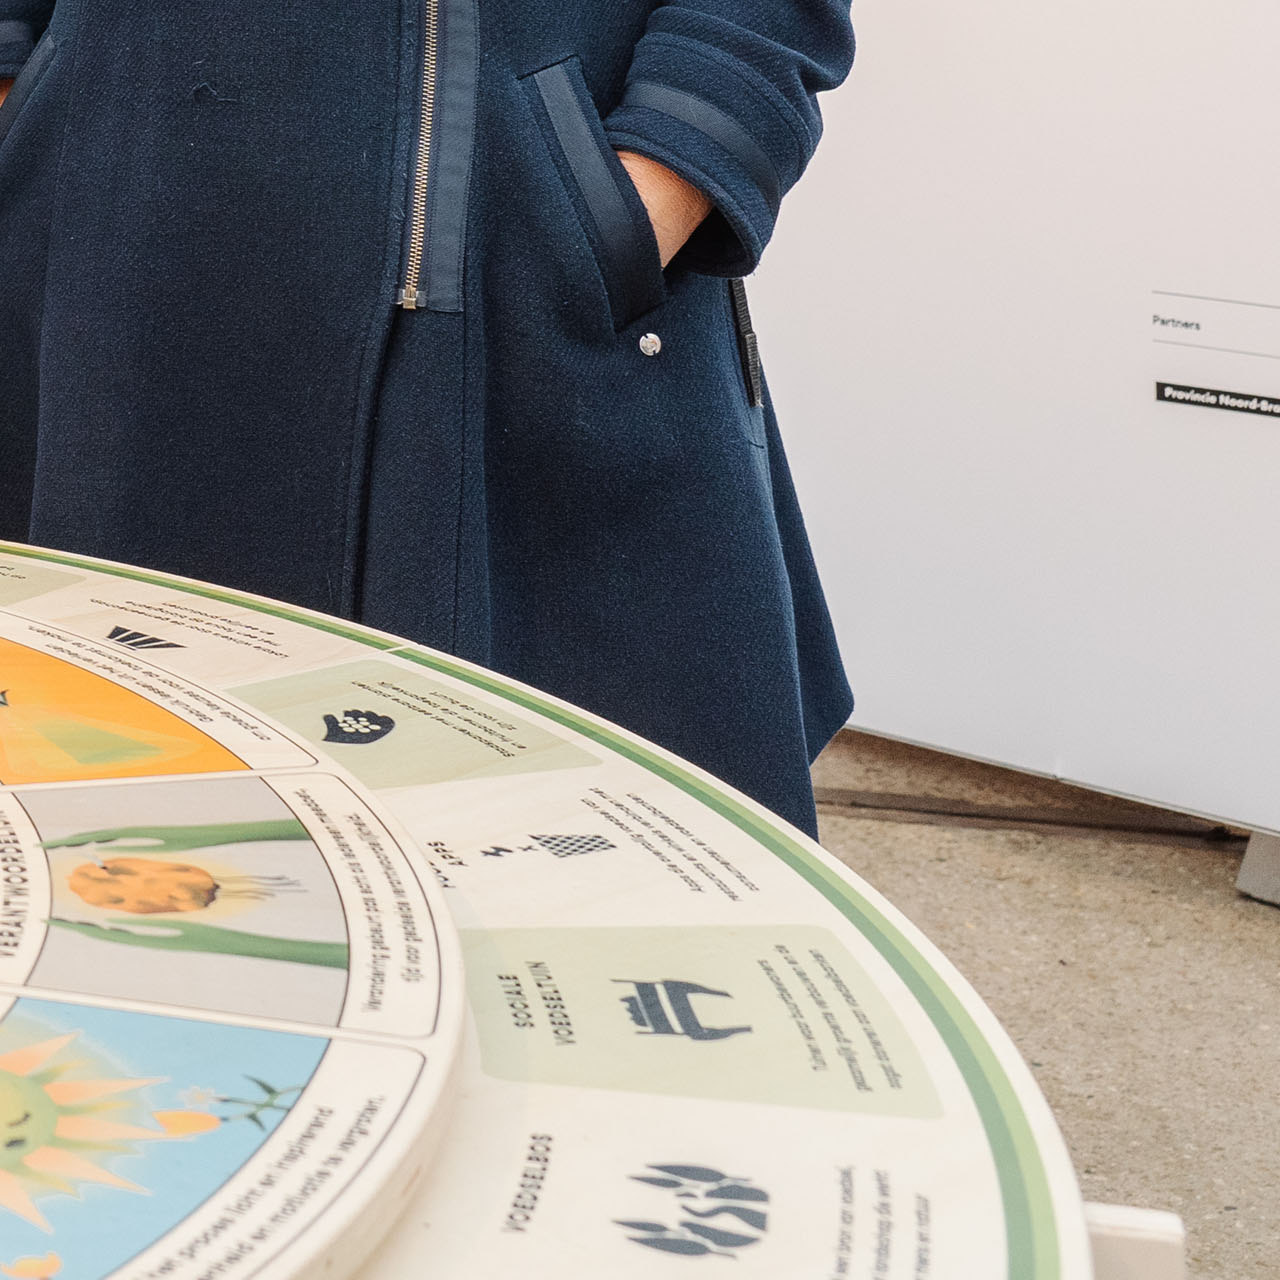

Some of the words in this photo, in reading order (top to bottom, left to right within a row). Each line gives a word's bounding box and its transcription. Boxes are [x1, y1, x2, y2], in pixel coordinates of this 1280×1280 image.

[1152, 315, 1201, 331] Partners
[1164, 386, 1217, 405] Provincie
[497, 975, 535, 1028] SOCIALE
[529, 962, 575, 1044] VOEDSELTUIN
[507, 1135, 553, 1232] VOEDSELBOS
